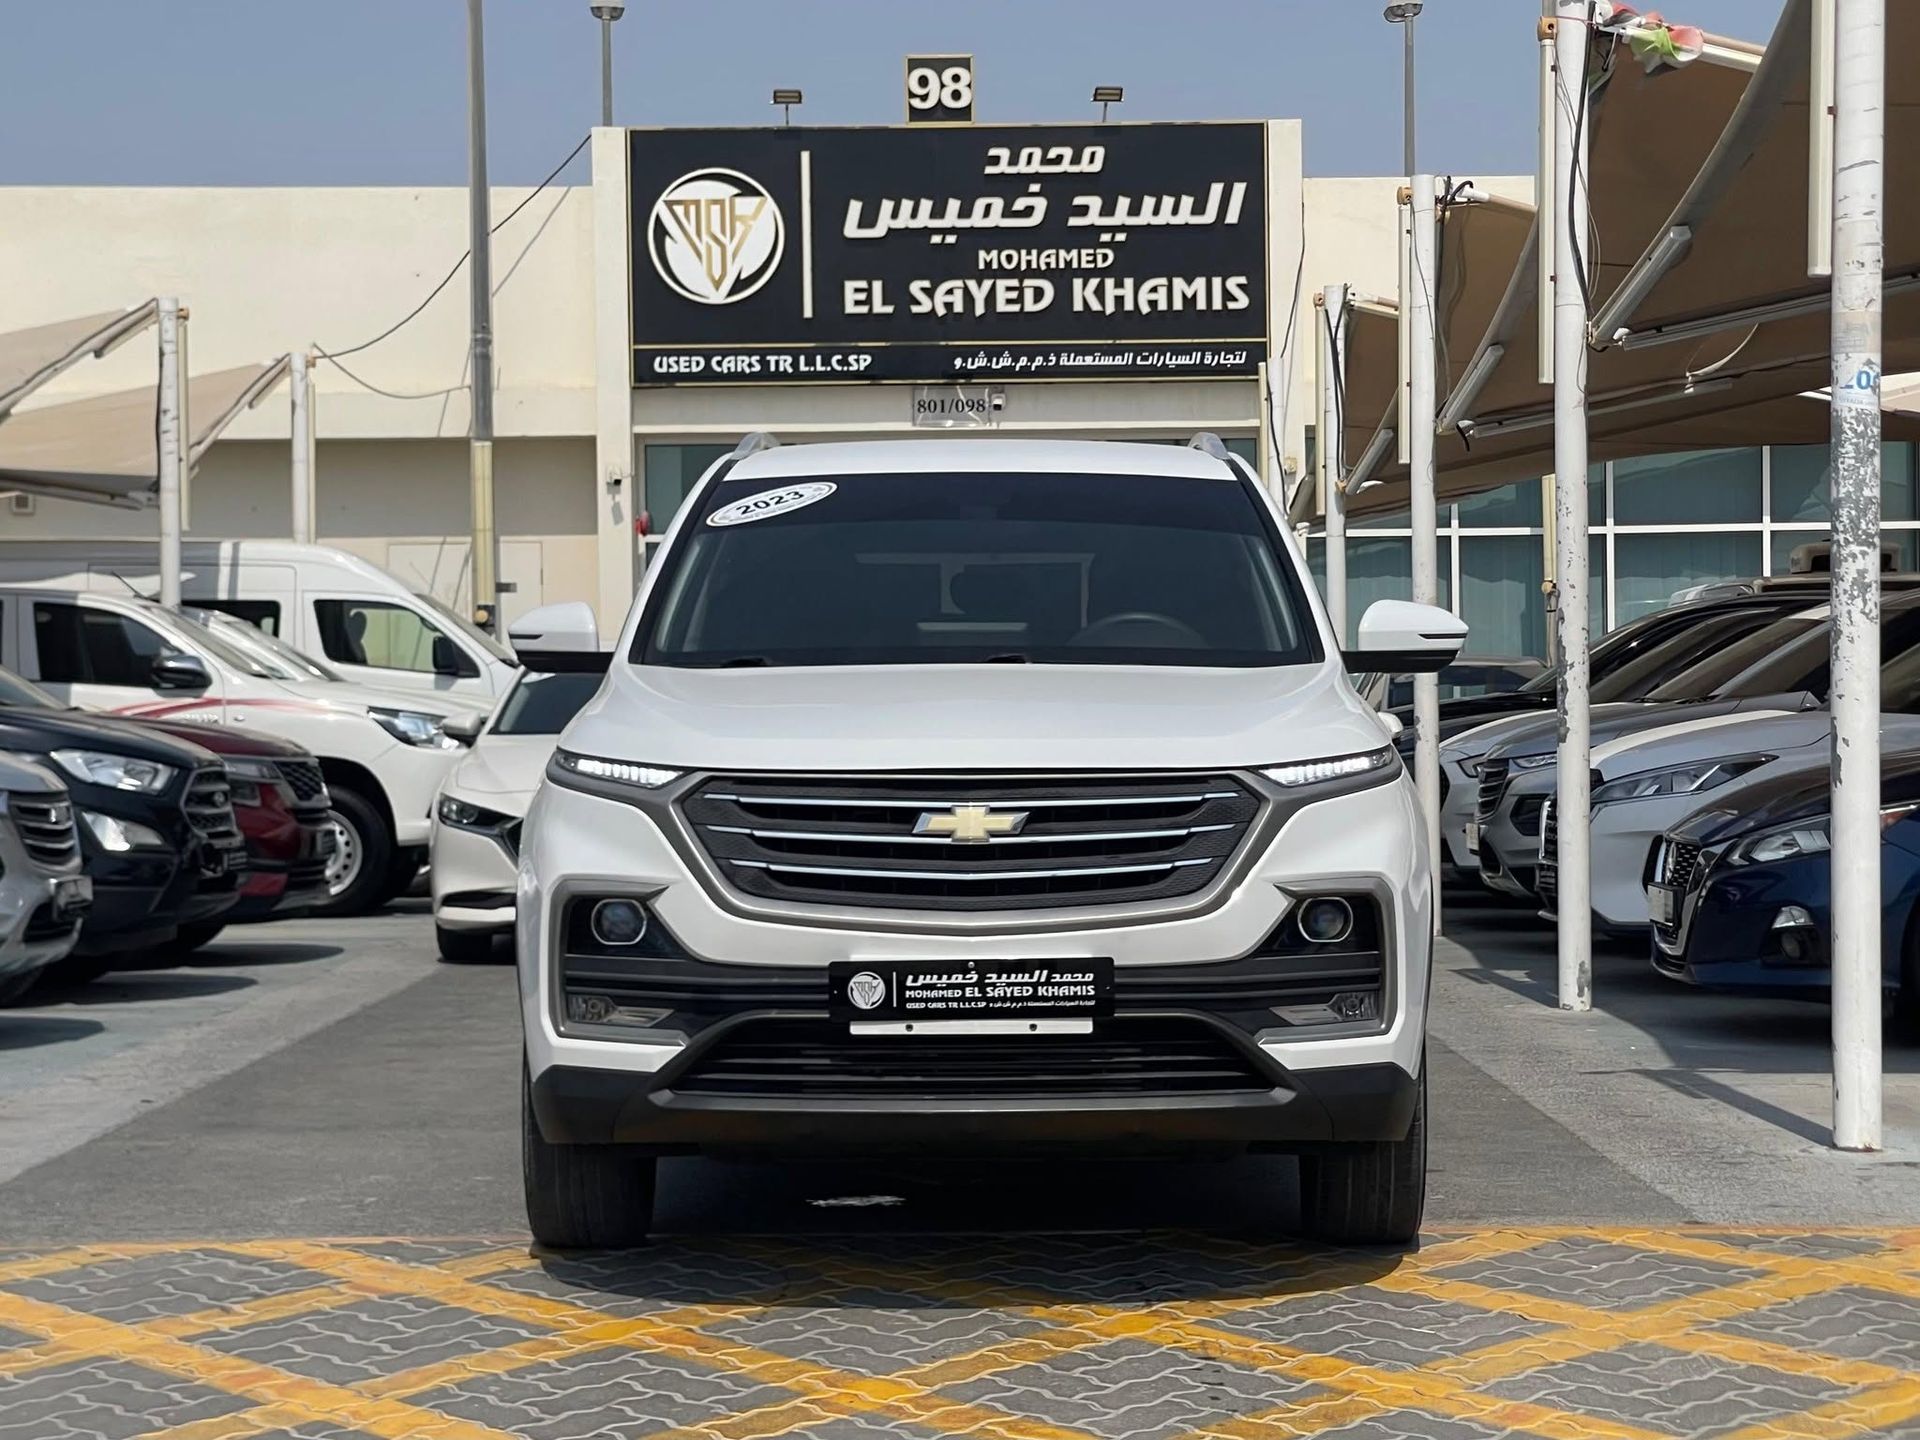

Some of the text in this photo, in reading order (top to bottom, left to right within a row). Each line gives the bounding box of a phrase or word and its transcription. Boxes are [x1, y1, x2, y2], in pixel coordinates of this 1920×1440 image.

[908, 66, 972, 110] 98
[983, 145, 1105, 175] محمد
[843, 181, 1248, 244] السيد خميس
[978, 248, 1115, 271] MOHAMED
[843, 275, 1250, 317] EL SAYED KHAMIS
[653, 354, 872, 374] USED CARS TR L.L.C.SP
[1059, 352, 1134, 366] المستعملة
[1136, 351, 1202, 369] السيارات
[1203, 350, 1247, 368] لتجارة
[917, 398, 986, 414] 801/098
[735, 490, 805, 515] 2023
[905, 969, 1094, 987] محمد السيد خميس
[905, 985, 1096, 998] MOHAMED EL SAYED KHAMIS
